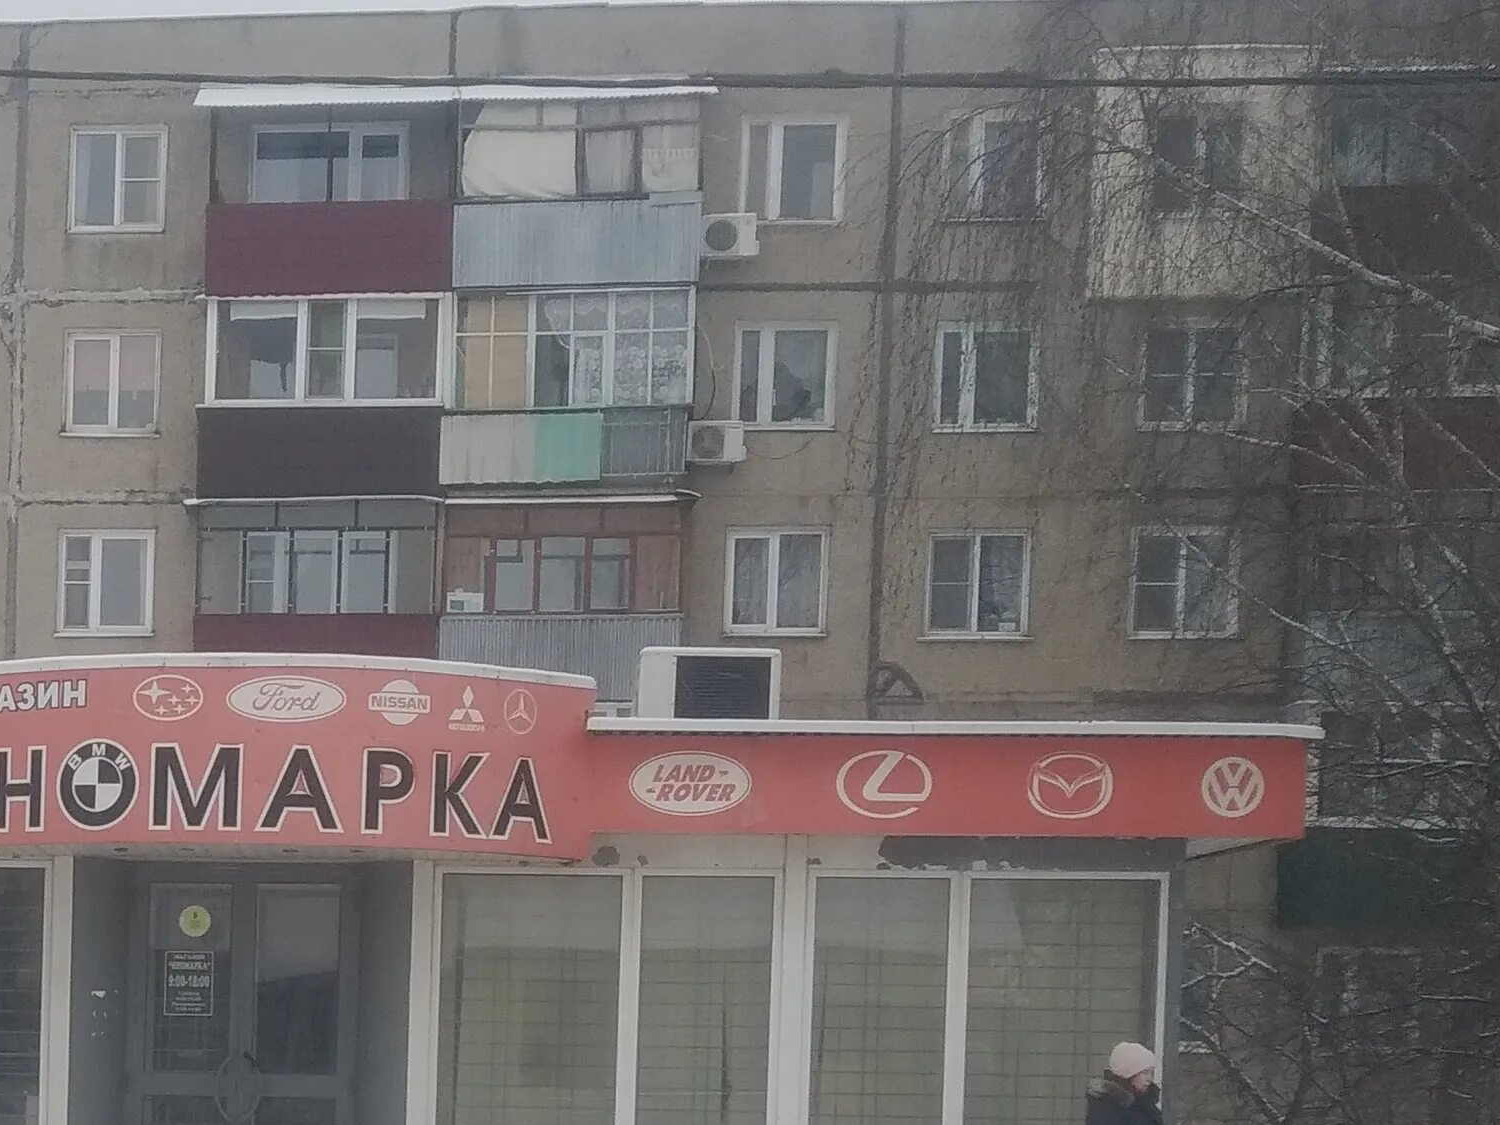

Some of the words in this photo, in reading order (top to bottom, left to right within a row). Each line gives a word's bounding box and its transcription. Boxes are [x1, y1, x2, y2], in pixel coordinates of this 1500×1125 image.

[252, 682, 322, 713] Ford
[371, 694, 430, 711] NISSAN
[67, 742, 135, 772] BMW
